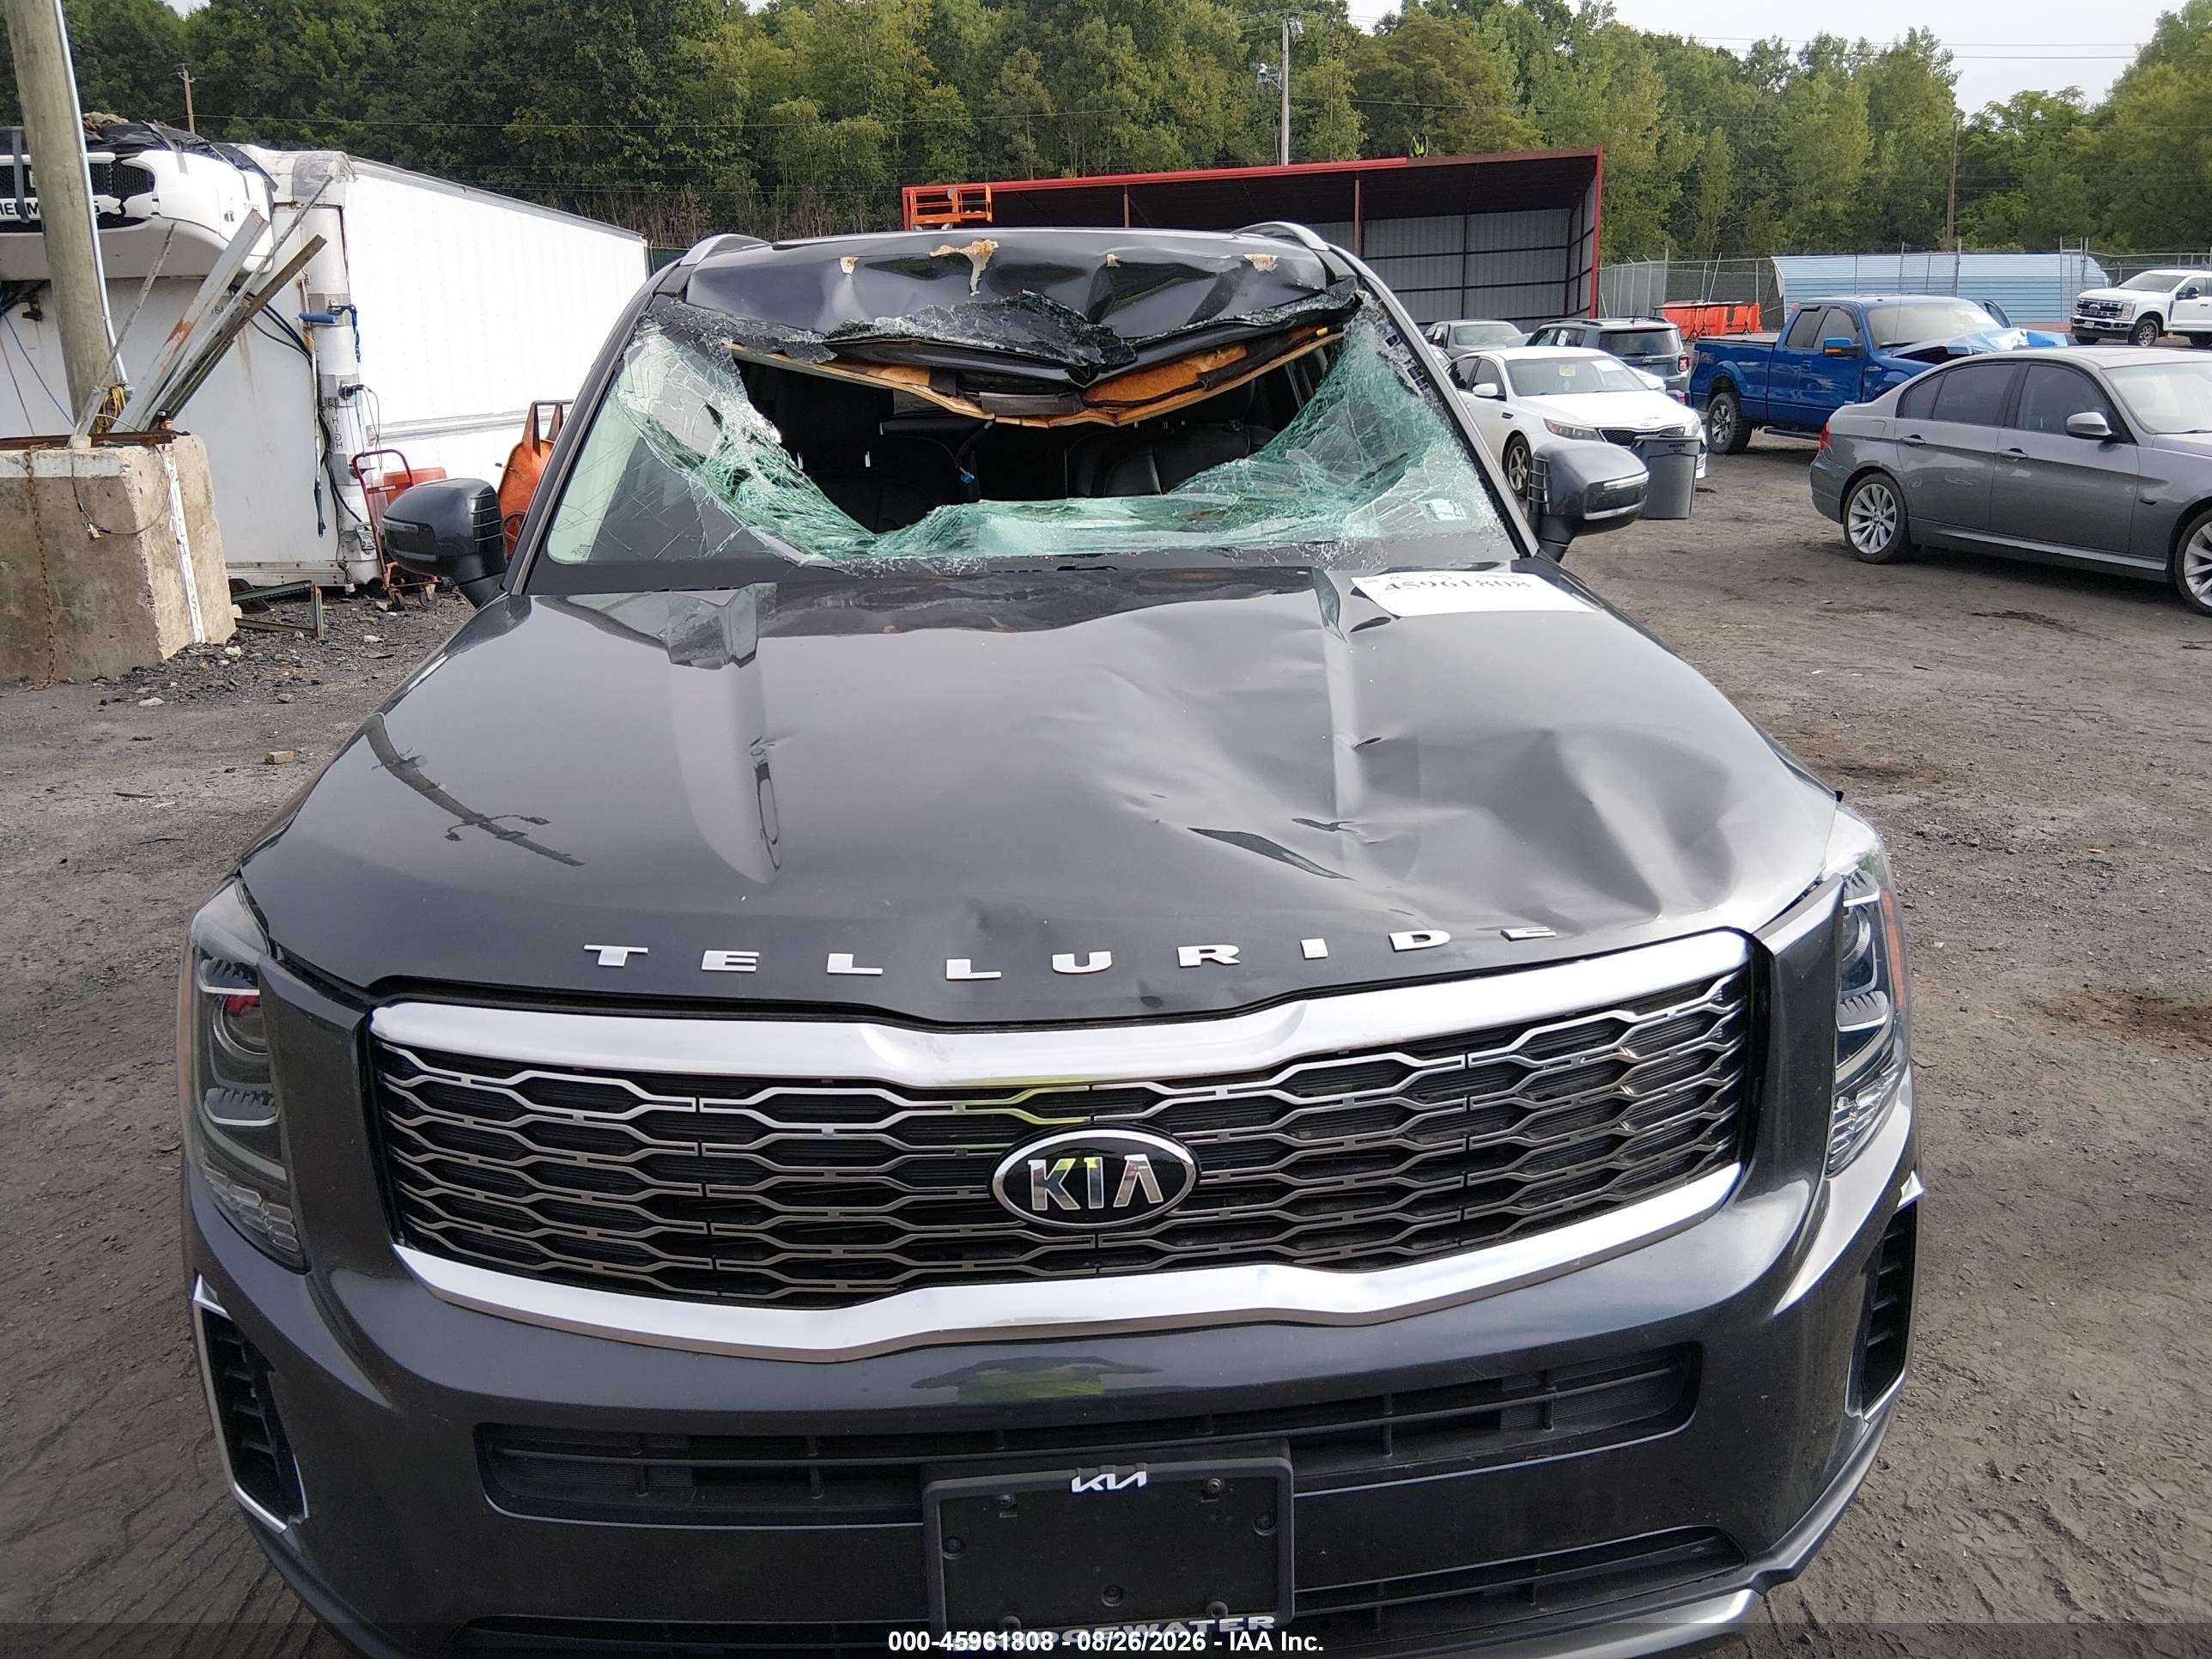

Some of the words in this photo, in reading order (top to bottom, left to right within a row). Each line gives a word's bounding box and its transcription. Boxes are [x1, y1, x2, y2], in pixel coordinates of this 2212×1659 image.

[583, 926, 1558, 981] TELLURIDE
[1028, 1153, 1164, 1212] KIA
[951, 1615, 1276, 1651] DGEWATER
